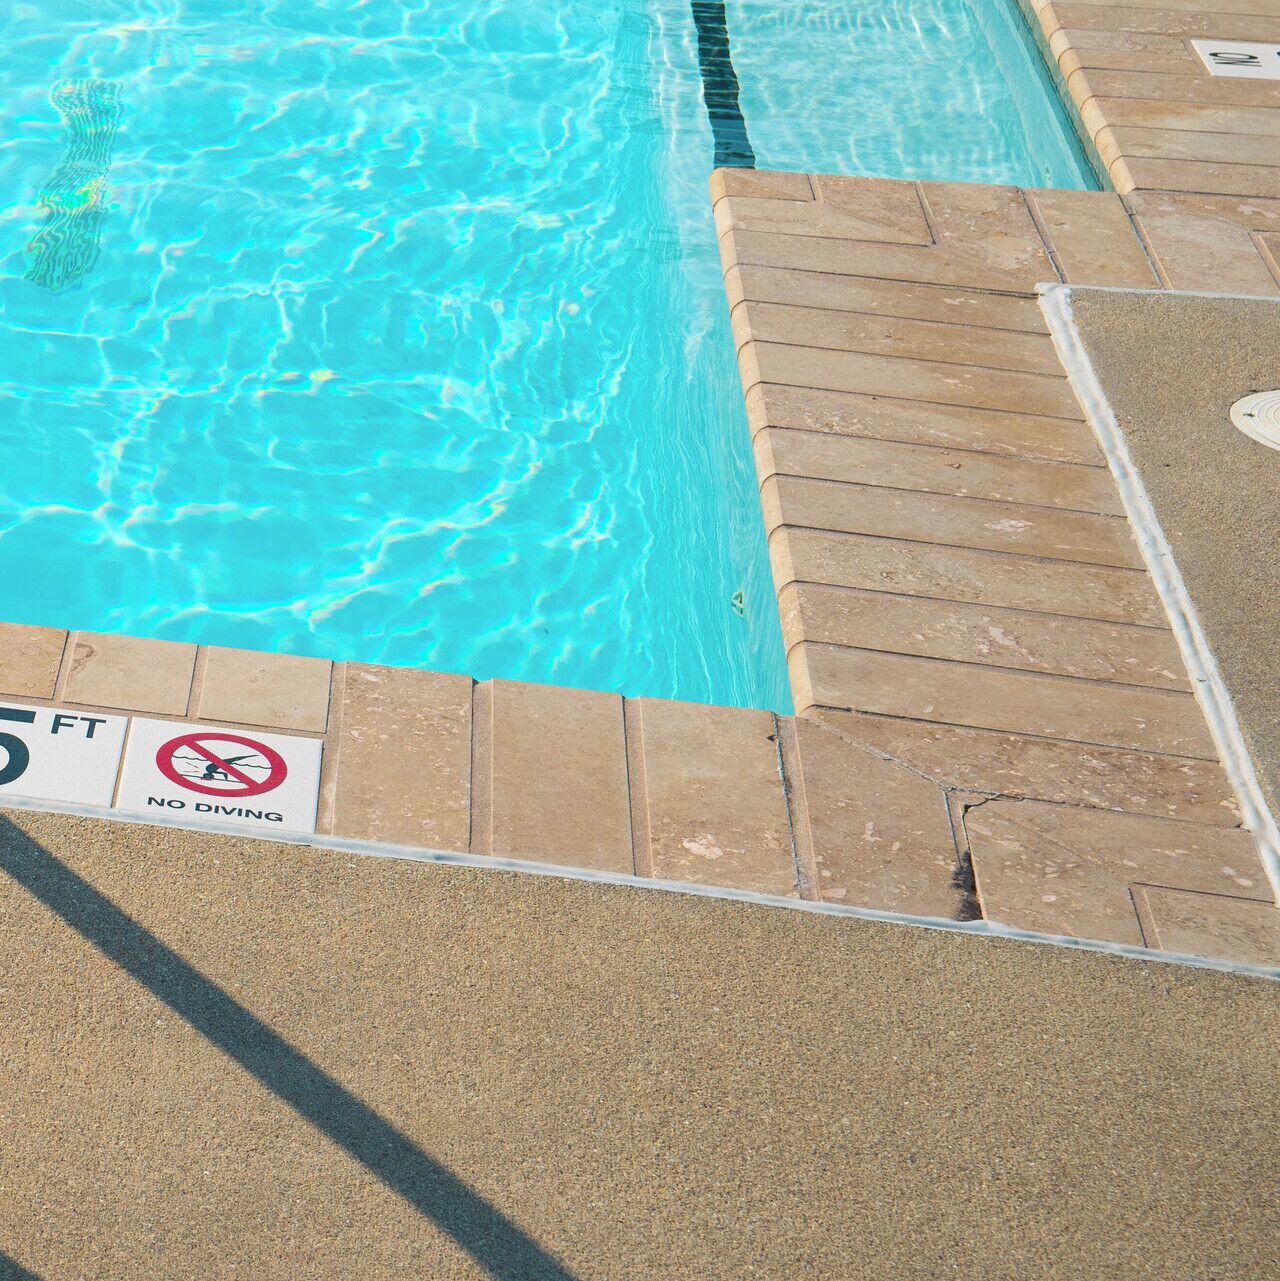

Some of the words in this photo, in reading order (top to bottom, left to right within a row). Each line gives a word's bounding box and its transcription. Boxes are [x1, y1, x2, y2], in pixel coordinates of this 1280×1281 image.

[50, 713, 107, 739] FT
[147, 796, 186, 810] NO
[194, 802, 284, 823] DIVING
